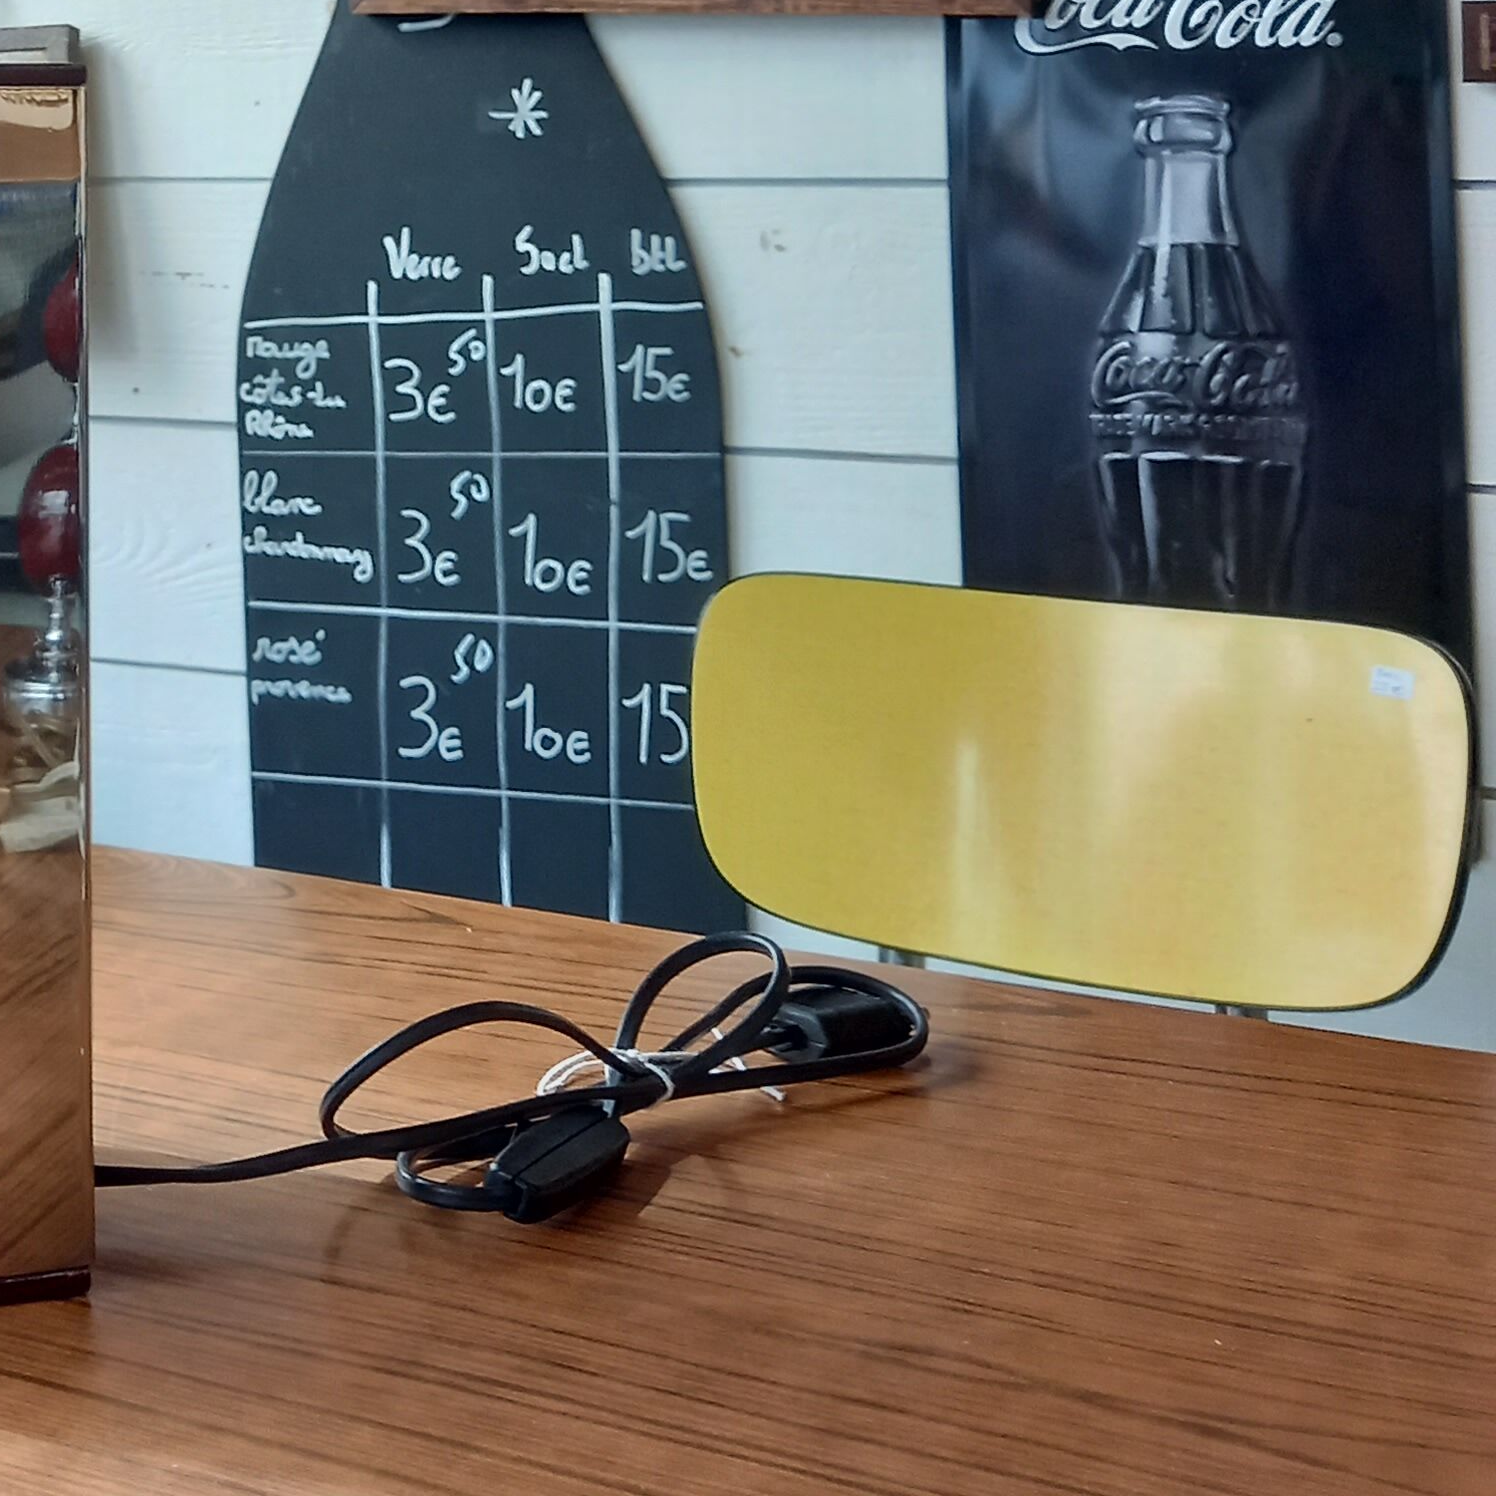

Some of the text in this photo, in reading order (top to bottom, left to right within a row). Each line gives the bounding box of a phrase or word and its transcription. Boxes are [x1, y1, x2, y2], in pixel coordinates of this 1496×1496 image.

[382, 225, 463, 282] Verre
[245, 334, 332, 380] rouge
[499, 353, 578, 413] 10€
[617, 342, 691, 403] 15€
[242, 468, 324, 516] blanc
[507, 512, 595, 596] 10€
[624, 508, 715, 584] 15€
[252, 627, 327, 665] rosé
[504, 681, 592, 765] 10€
[620, 681, 690, 766] 15
